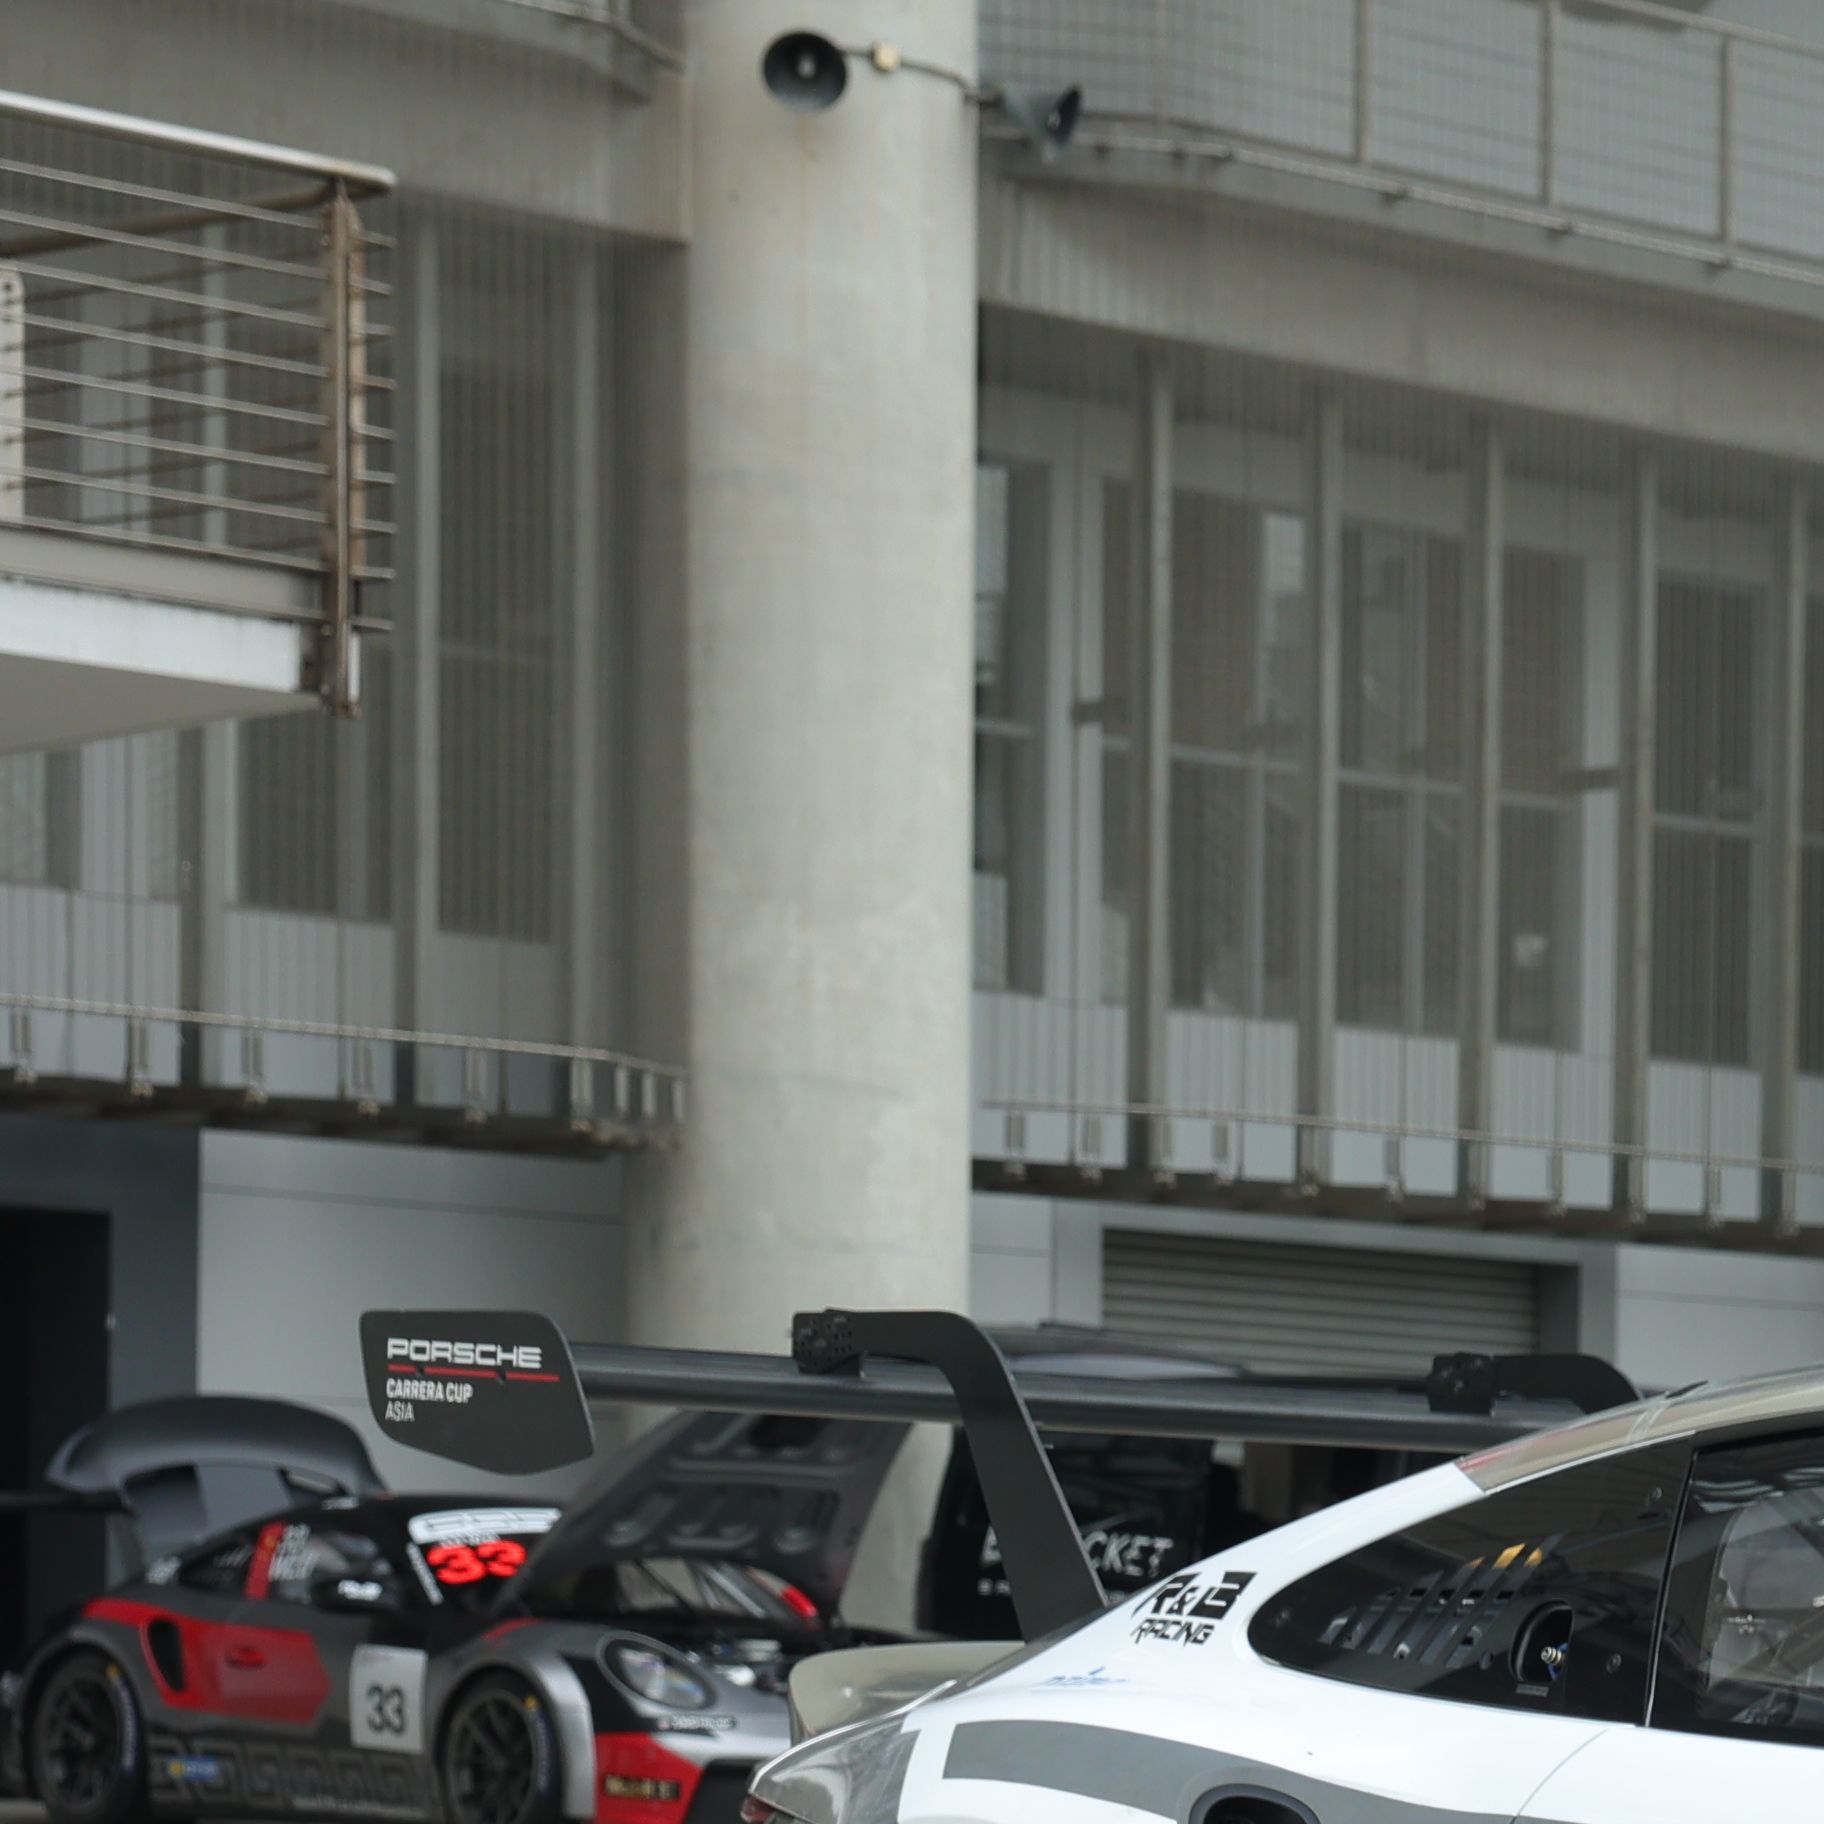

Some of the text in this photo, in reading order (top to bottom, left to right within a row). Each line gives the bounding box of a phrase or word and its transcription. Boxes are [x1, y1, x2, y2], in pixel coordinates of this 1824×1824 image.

[387, 1337, 542, 1369] PORSCHE
[386, 1378, 473, 1403] CARRERA CUP
[385, 1400, 415, 1422] ASIA
[426, 1538, 528, 1585] 33
[1130, 1617, 1215, 1647] RACING
[366, 1684, 407, 1735] 33
